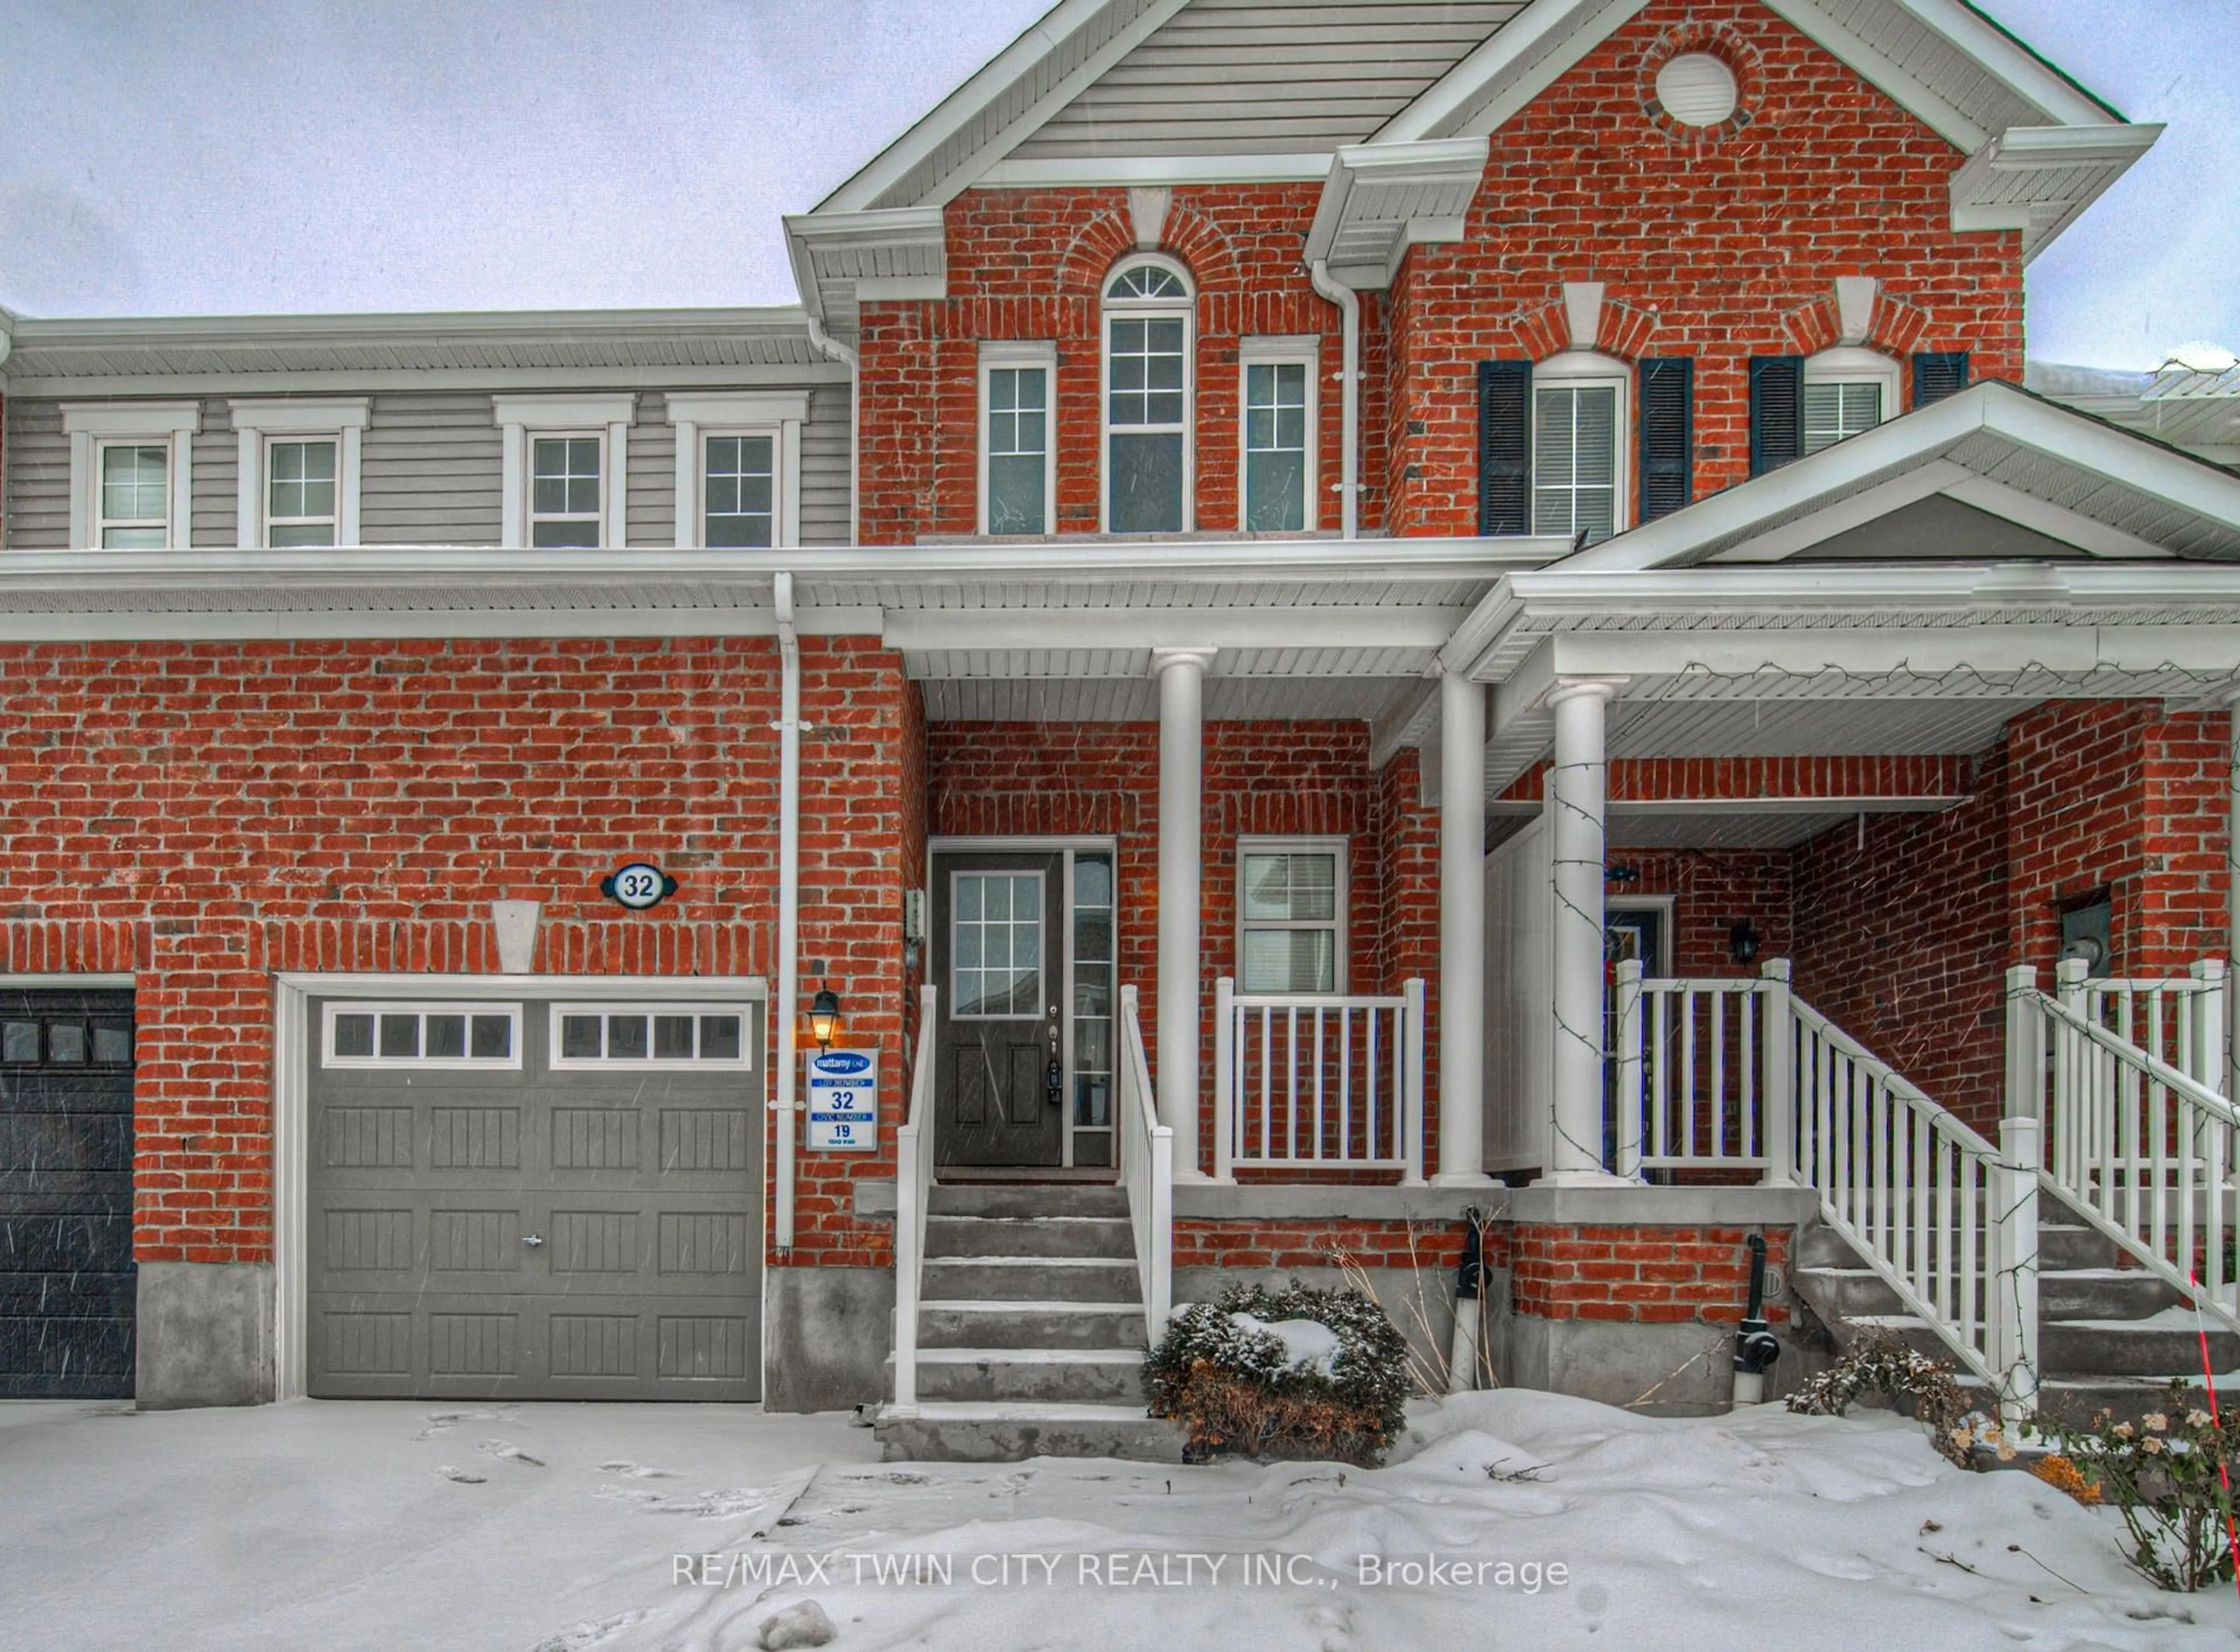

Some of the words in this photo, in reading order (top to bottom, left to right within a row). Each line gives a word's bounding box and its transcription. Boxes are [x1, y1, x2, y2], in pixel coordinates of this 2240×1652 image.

[625, 875, 653, 897] 32
[817, 1058, 850, 1069] mattamy
[832, 1092, 853, 1110] 32
[835, 1124, 850, 1138] 19
